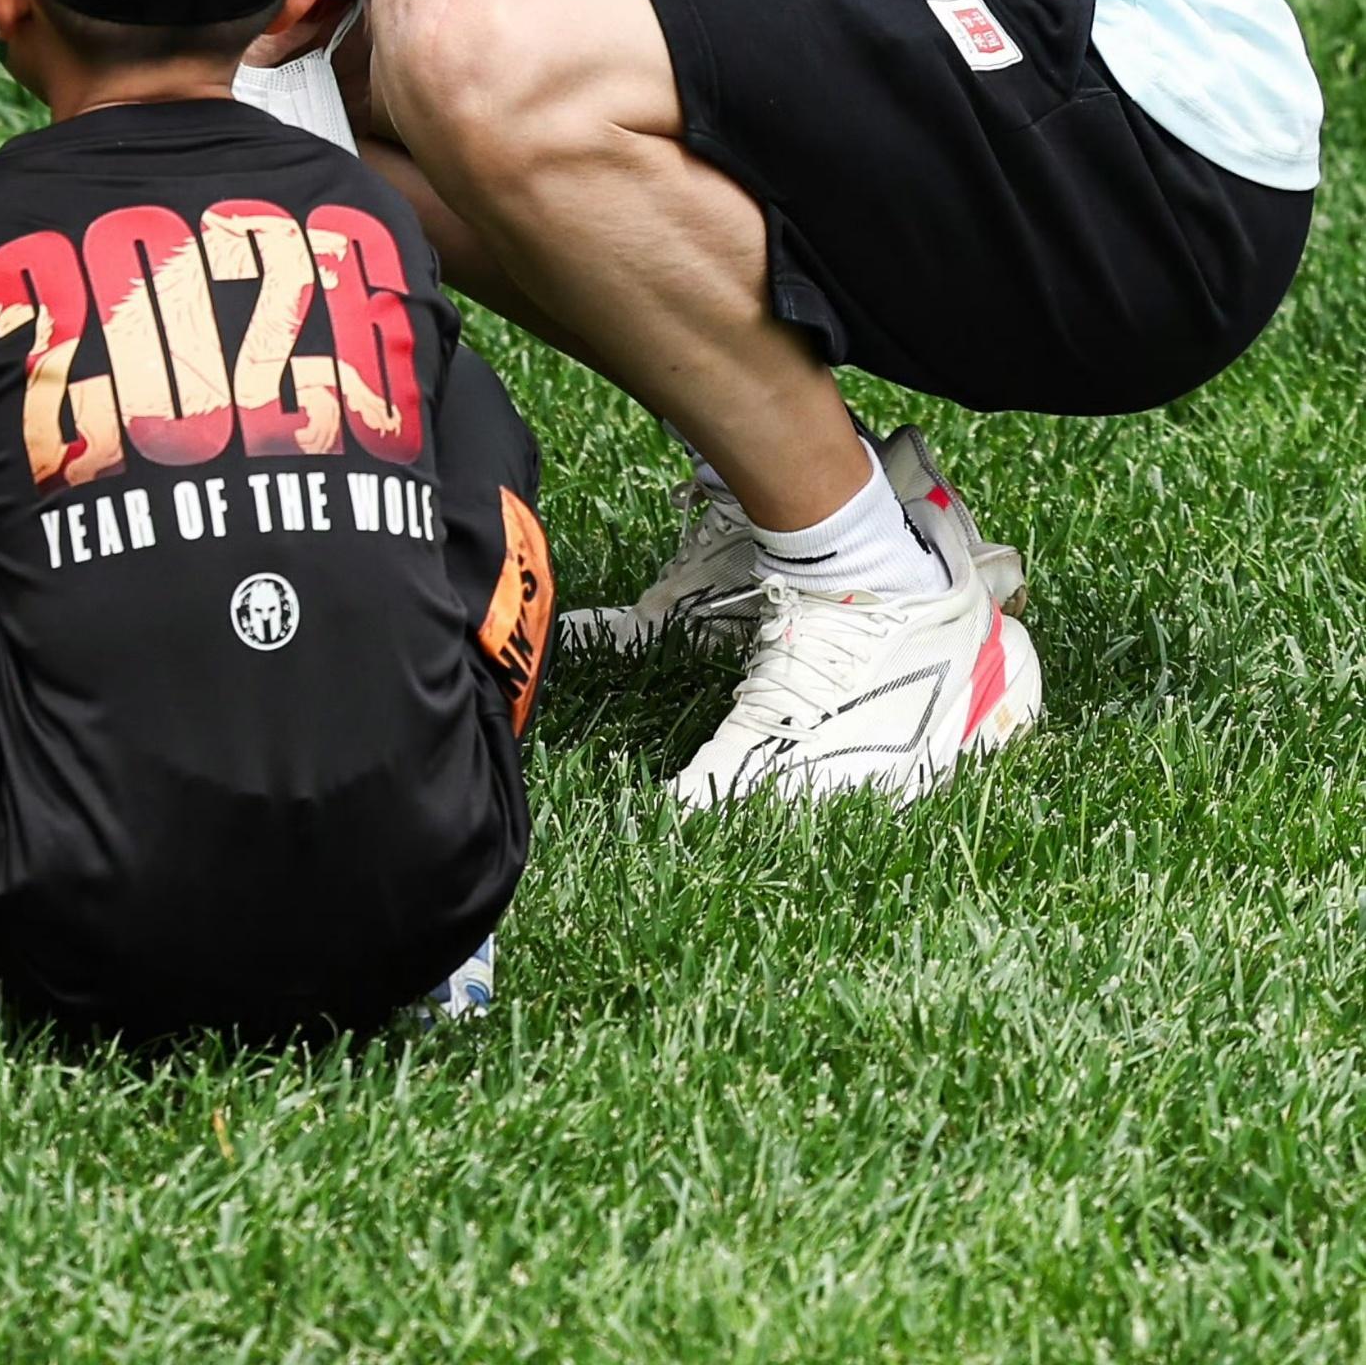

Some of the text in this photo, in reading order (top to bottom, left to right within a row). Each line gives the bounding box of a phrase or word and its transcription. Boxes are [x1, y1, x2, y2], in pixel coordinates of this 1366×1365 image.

[40, 471, 435, 569] YEAR OF THE WOLF
